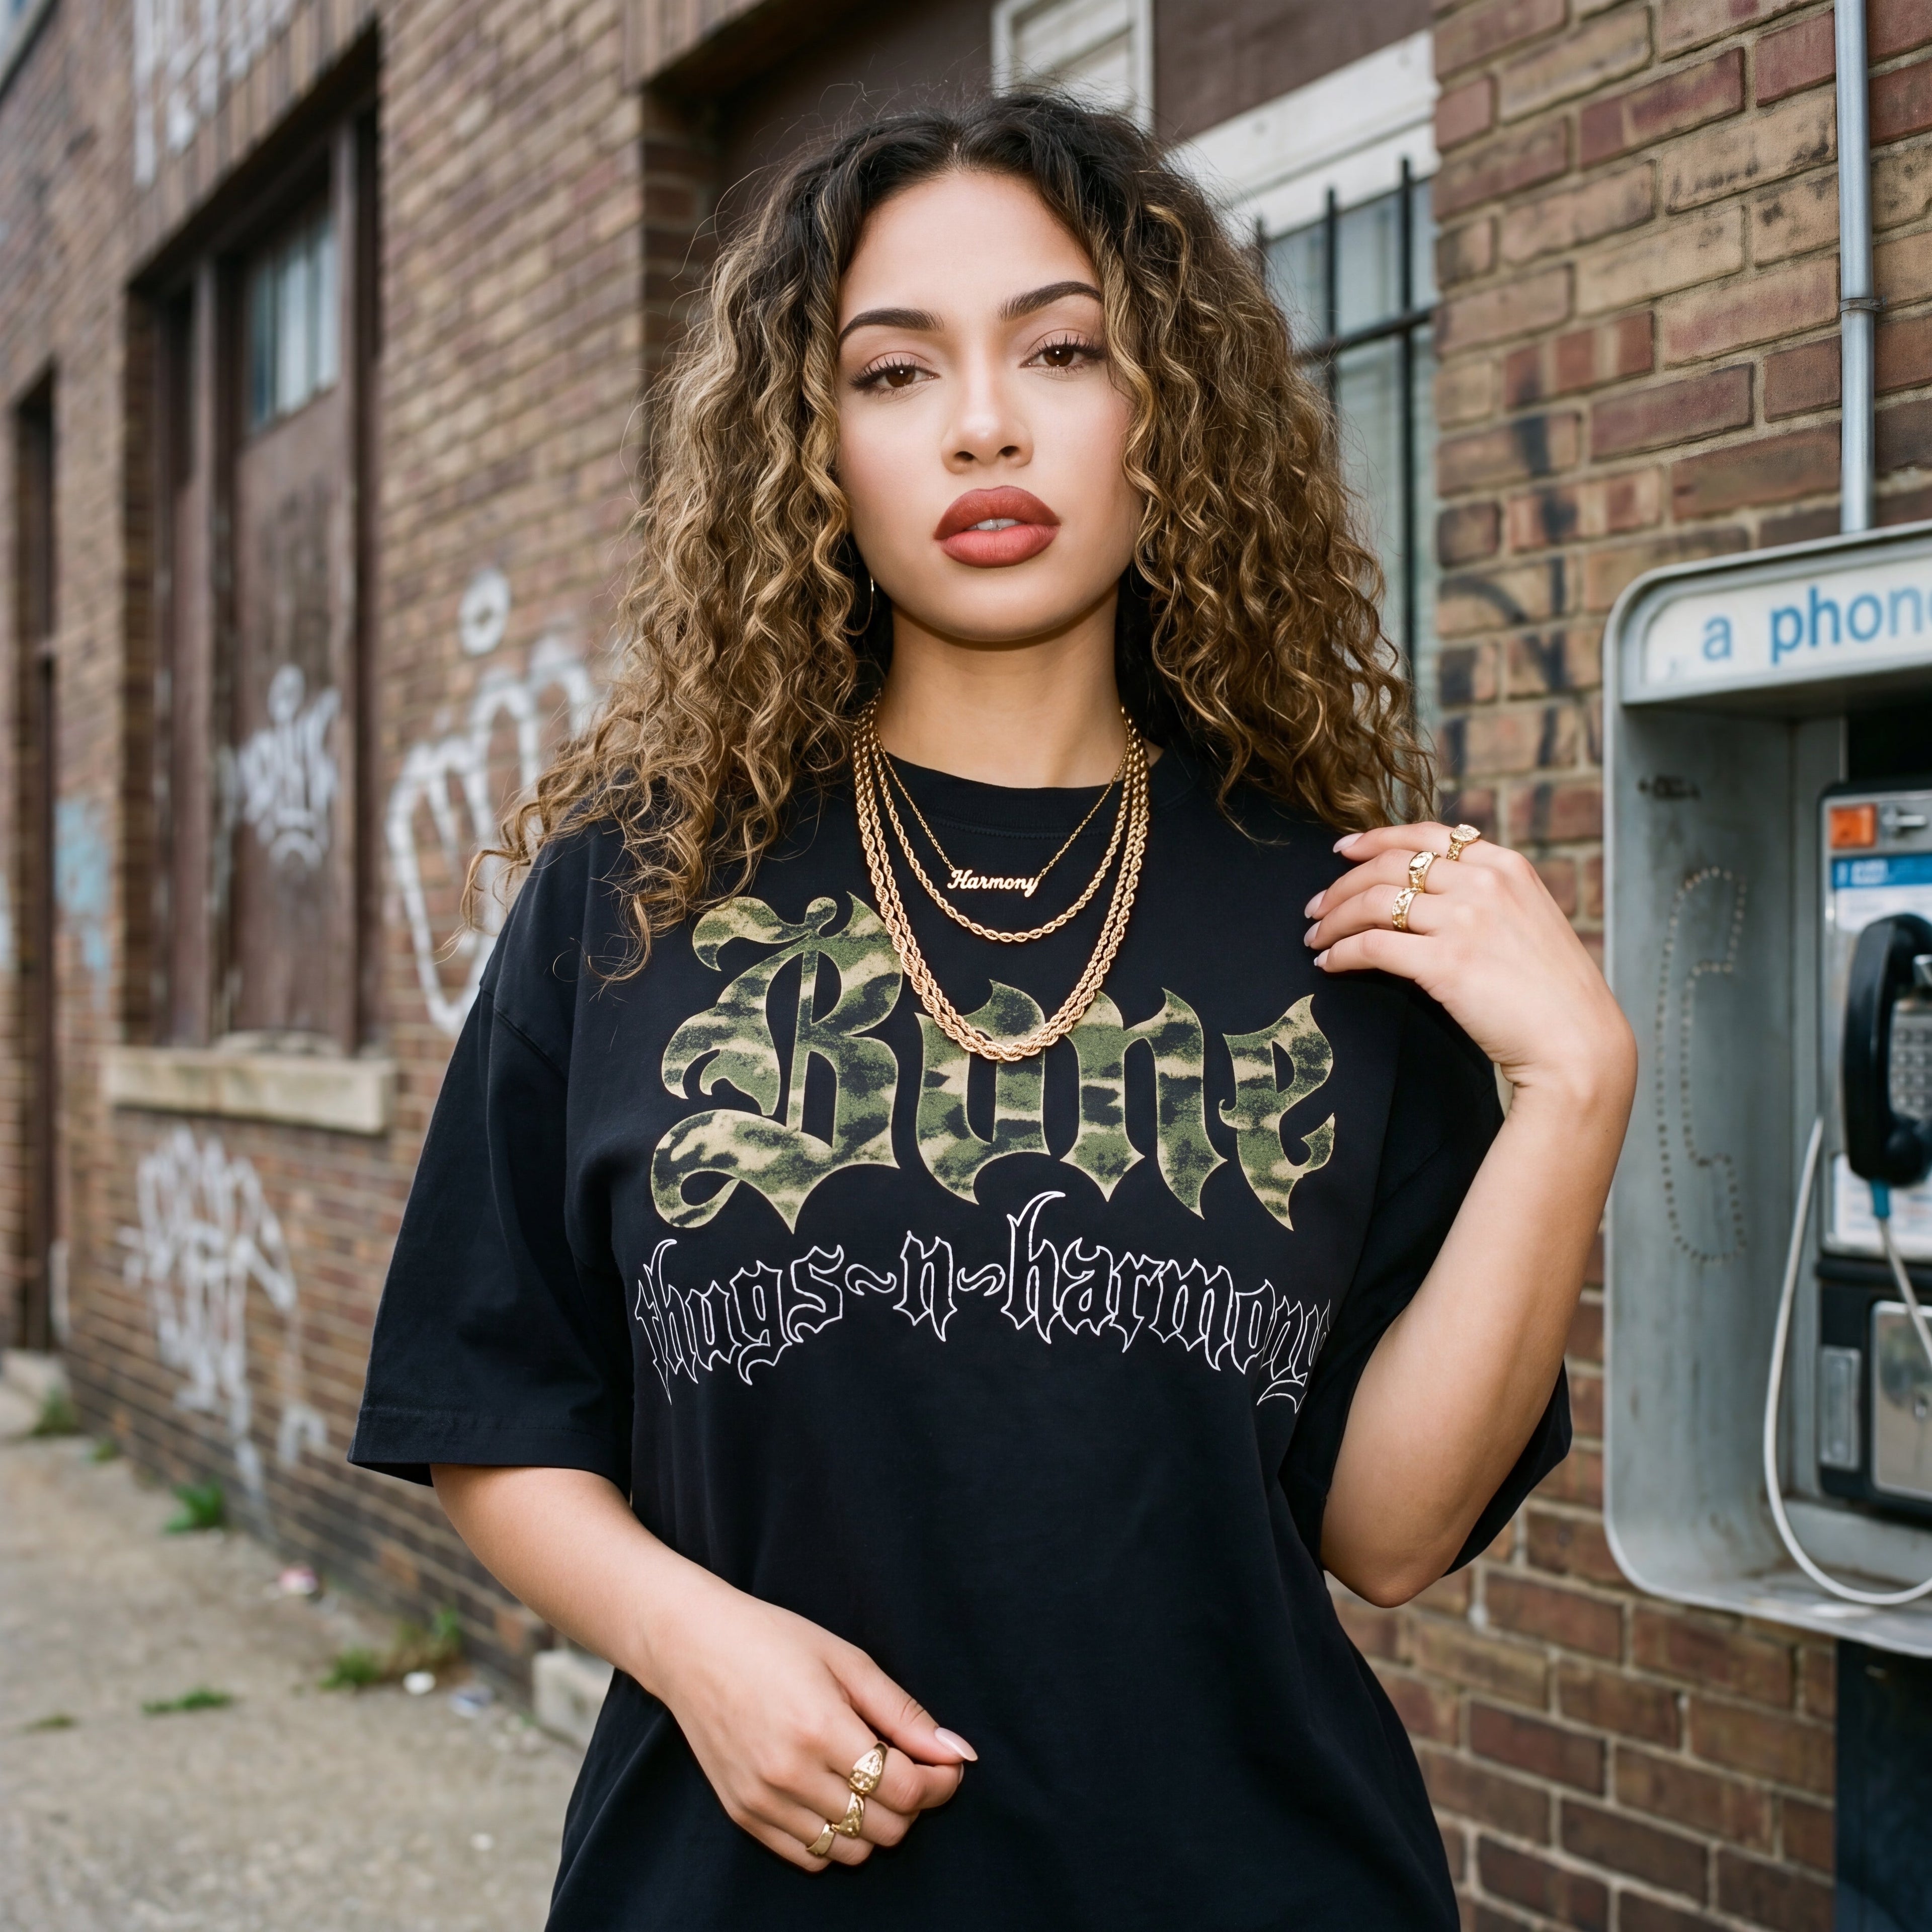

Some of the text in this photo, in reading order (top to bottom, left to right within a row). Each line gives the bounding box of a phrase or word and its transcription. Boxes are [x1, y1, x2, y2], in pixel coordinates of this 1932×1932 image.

[1703, 585, 1932, 665] a phon
[947, 870, 1037, 898] Harmony
[651, 892, 1334, 1233] Bone
